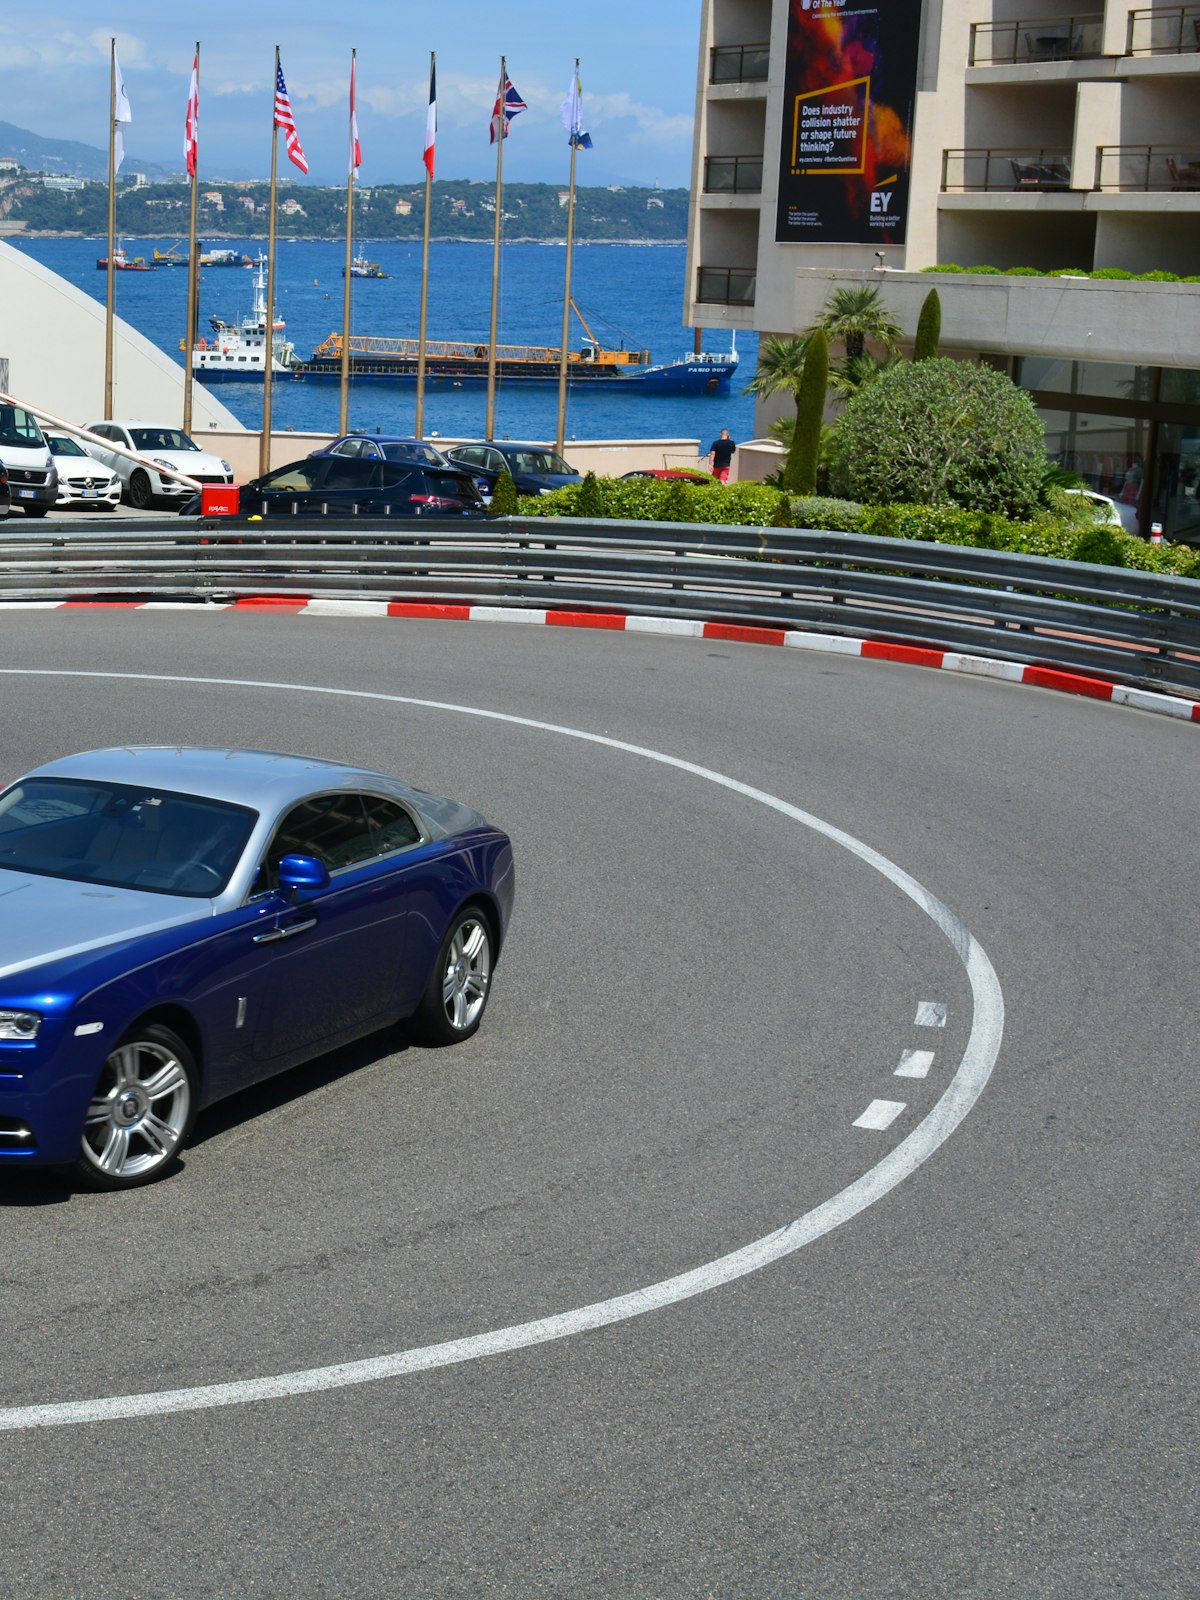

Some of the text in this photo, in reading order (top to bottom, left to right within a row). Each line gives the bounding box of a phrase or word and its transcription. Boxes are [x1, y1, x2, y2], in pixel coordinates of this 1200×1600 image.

[812, 0, 820, 9] Of
[821, 0, 832, 8] The
[802, 104, 853, 116] Does industry
[801, 116, 861, 128] collision shatter
[801, 129, 857, 141] or shape future
[800, 141, 834, 153] thinking?
[870, 192, 892, 212] EY
[869, 214, 885, 222] Building
[869, 221, 884, 229] working
